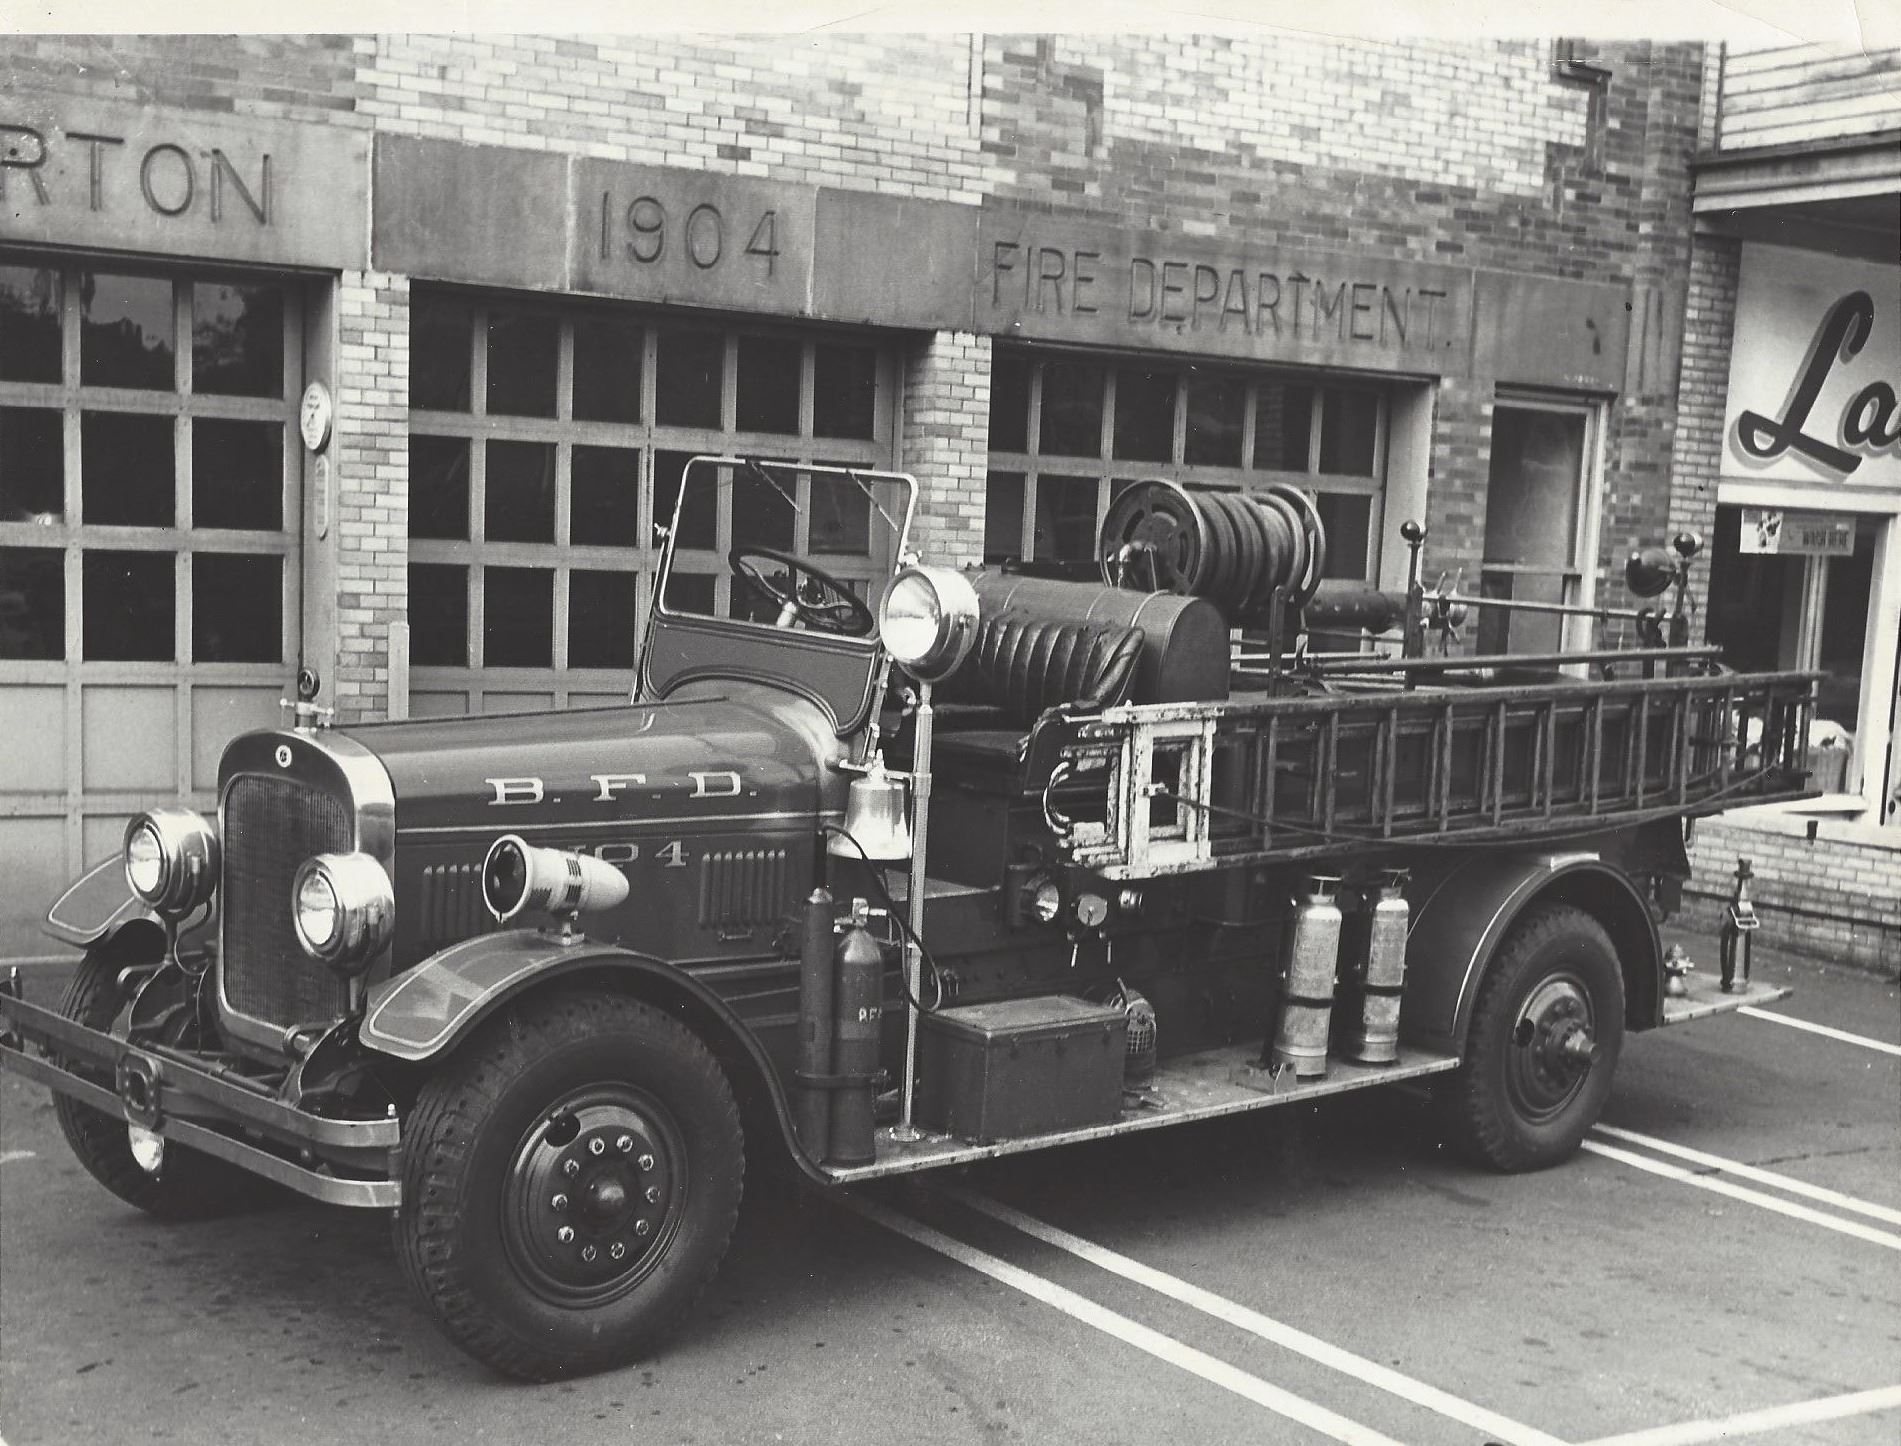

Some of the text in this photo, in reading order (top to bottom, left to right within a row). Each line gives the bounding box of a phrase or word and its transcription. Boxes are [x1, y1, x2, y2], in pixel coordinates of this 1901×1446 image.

[600, 191, 780, 277] 1904
[992, 241, 1447, 350] FIRE DEPARTMENT
